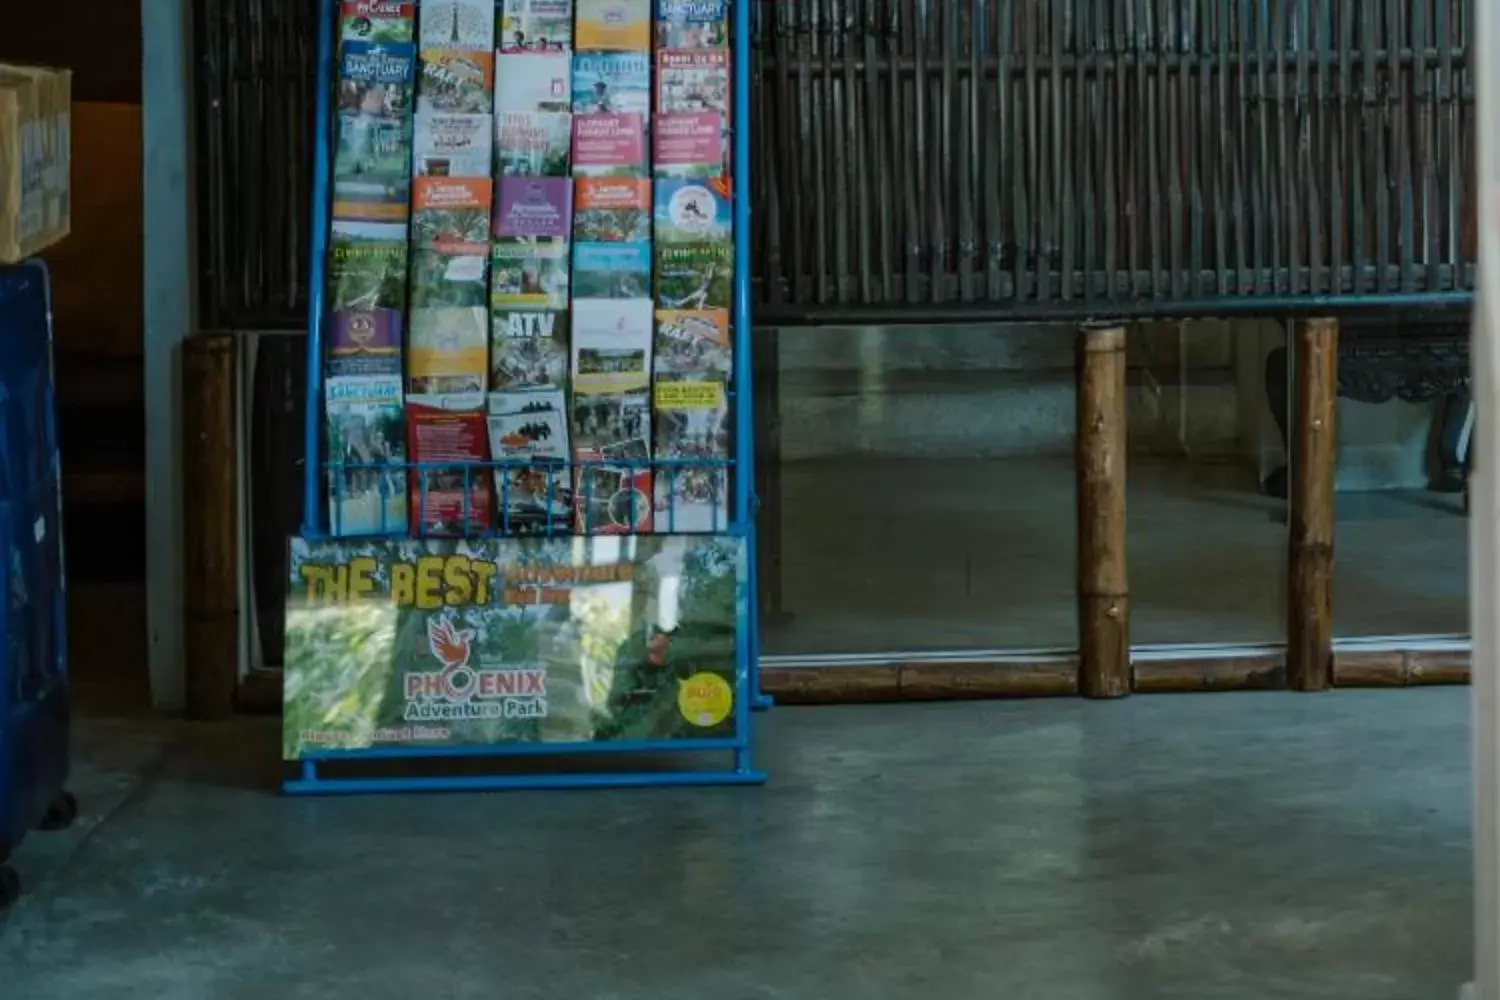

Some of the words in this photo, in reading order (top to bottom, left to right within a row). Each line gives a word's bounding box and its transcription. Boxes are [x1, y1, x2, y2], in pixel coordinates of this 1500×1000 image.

[345, 60, 409, 80] SANCTUARY
[507, 312, 556, 337] ATV
[301, 555, 377, 605] THE
[390, 554, 497, 610] BEST
[405, 670, 547, 699] PHOENIX
[405, 700, 501, 720] Adventure
[504, 700, 548, 718] Park
